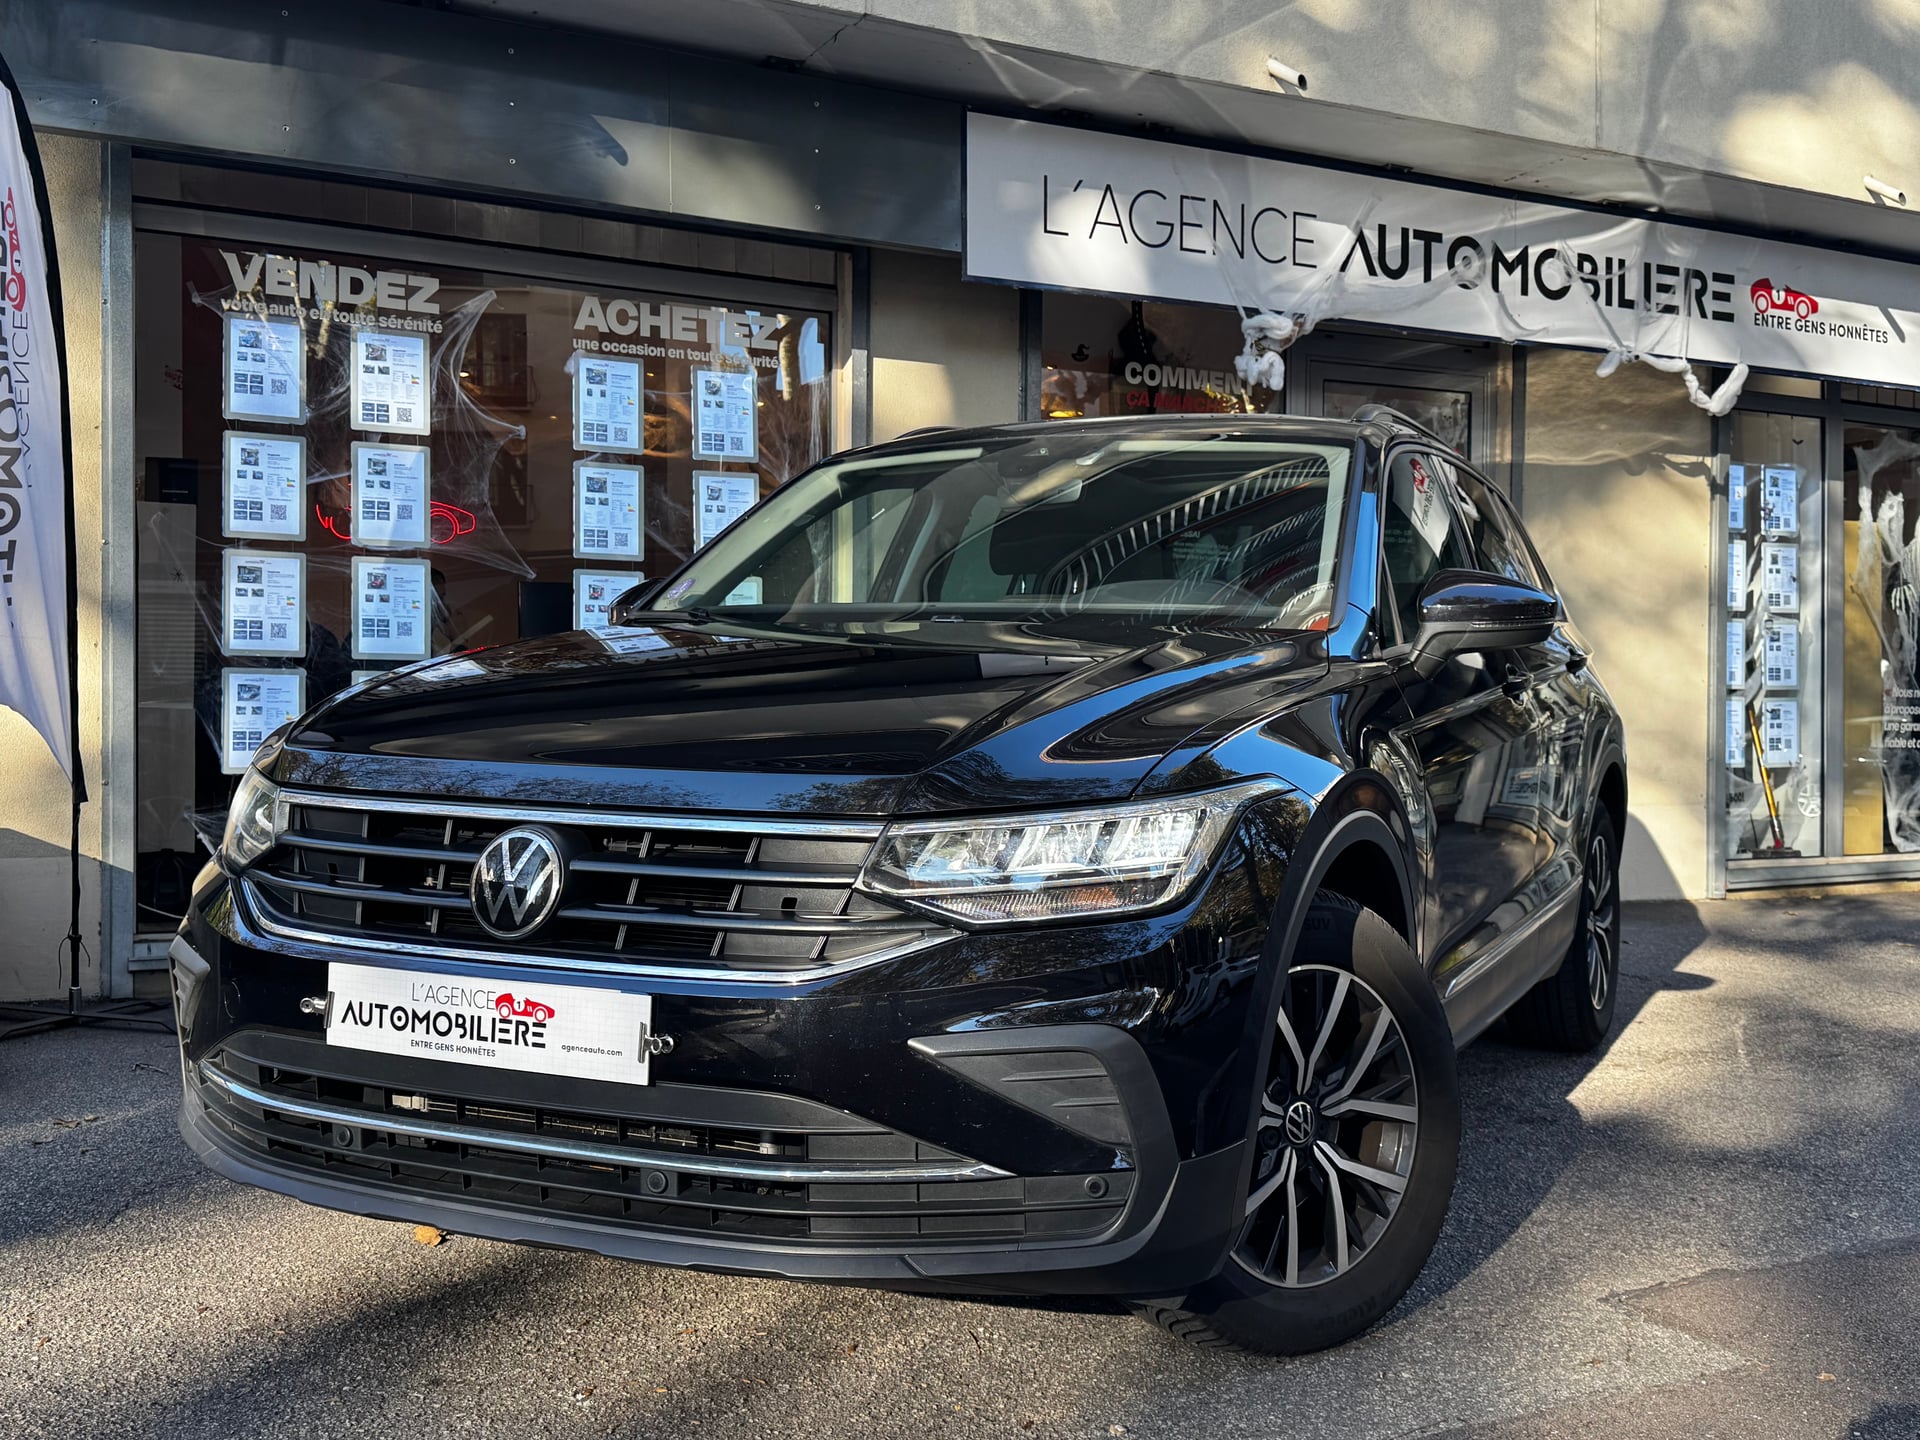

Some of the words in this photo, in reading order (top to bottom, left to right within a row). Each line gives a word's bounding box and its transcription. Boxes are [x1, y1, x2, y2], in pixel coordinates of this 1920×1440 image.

[221, 251, 440, 314] VENDEZ
[1340, 224, 1735, 323] AUTOMOBILIERE
[220, 298, 266, 313] votre
[269, 303, 306, 318] auto
[333, 310, 376, 326] toute
[378, 314, 443, 334] sérénité
[573, 296, 778, 351] ACHETEZ
[1754, 313, 1791, 330] ENTRE
[1795, 319, 1825, 335] GENS
[1829, 323, 1888, 344] HONNÊTES
[572, 338, 599, 351] une
[601, 341, 665, 357] occasion
[667, 348, 685, 360] en
[687, 349, 722, 363] toute
[412, 982, 496, 1010] L'AGENCE
[341, 999, 547, 1049] AUTOMOBILIERE
[411, 1039, 433, 1050] ENTRE
[435, 1043, 454, 1053] GENS
[456, 1044, 495, 1057] HONNÊTES
[561, 1044, 623, 1056] agenceauto.com
